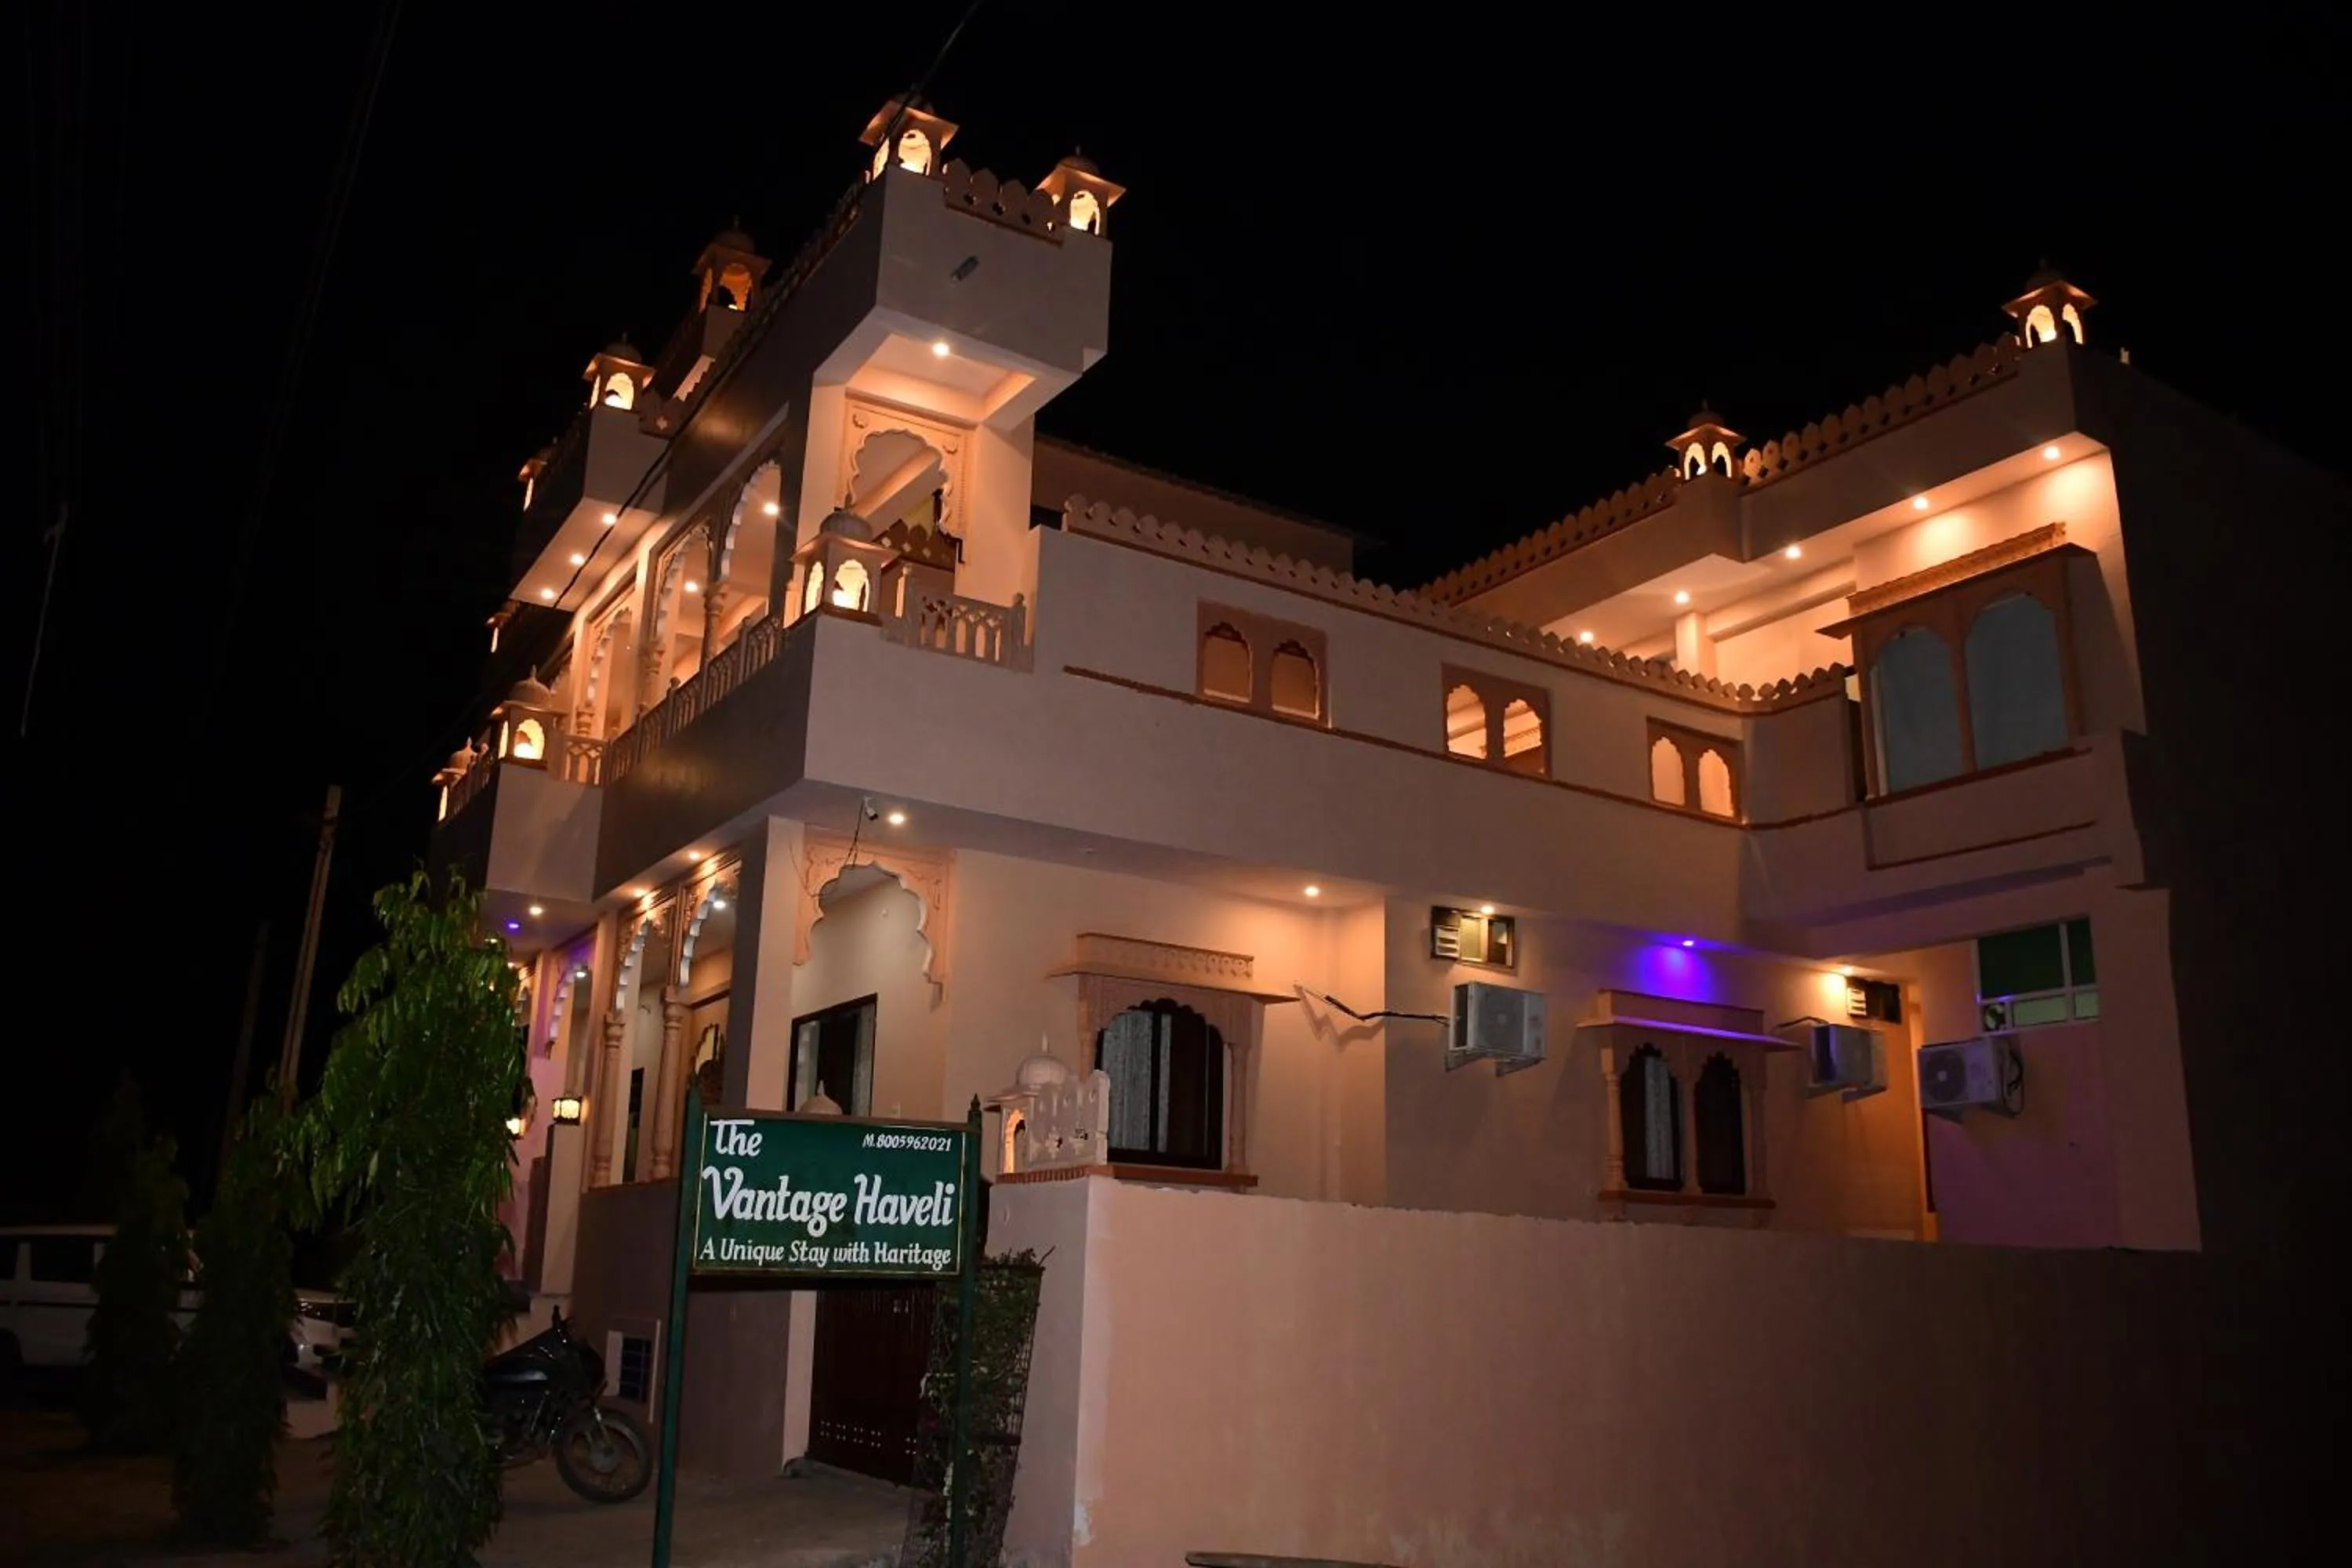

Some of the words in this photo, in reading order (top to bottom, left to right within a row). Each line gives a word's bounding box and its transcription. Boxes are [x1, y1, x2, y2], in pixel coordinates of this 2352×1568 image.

[710, 1119, 763, 1156] The
[700, 1166, 848, 1237] Vantage
[854, 1173, 956, 1227] Haveli
[699, 1236, 715, 1260] A
[720, 1238, 785, 1266] Unique
[789, 1240, 829, 1267] Stay
[833, 1240, 869, 1264] with
[873, 1241, 951, 1271] Haritage
